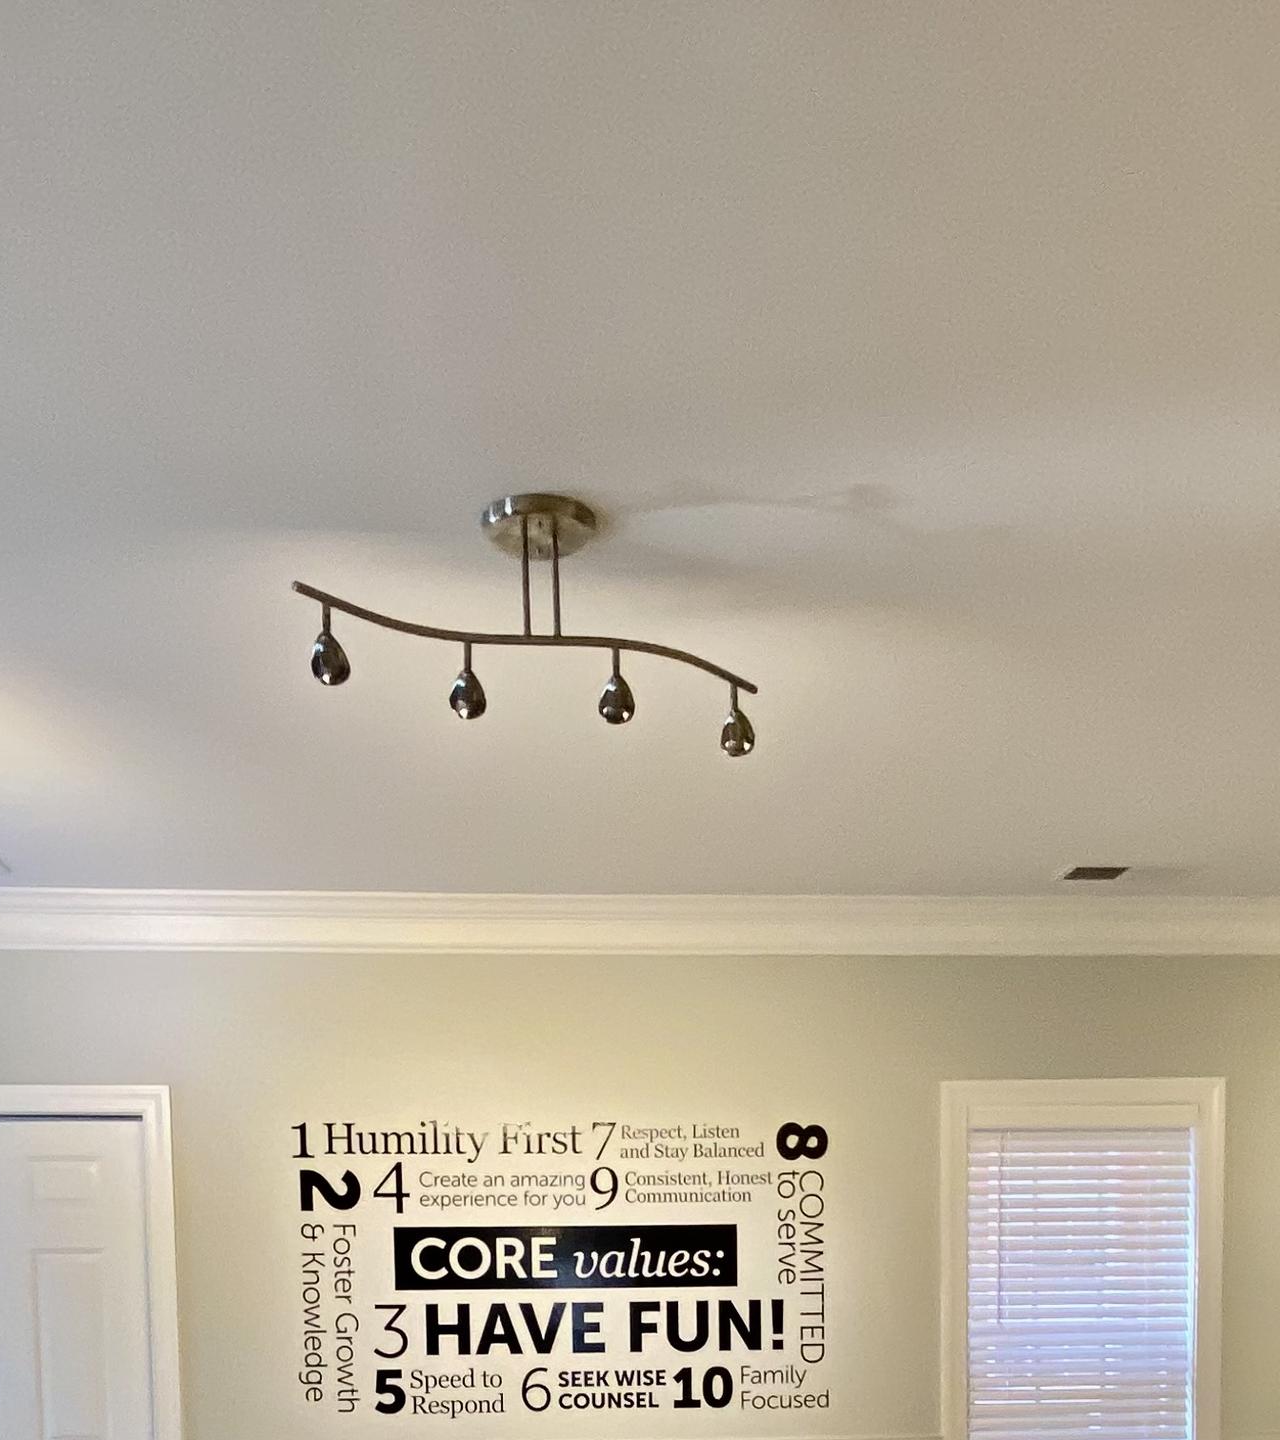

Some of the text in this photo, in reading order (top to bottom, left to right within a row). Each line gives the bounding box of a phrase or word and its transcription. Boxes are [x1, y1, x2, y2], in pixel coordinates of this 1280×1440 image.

[291, 1121, 582, 1164] 1 Humility First
[592, 1122, 739, 1160] 7 Respect, Listen
[620, 1142, 764, 1161] and Stay Balanced
[374, 1162, 585, 1213] 4 Create an amazing
[420, 1191, 585, 1210] experience for you
[590, 1167, 772, 1210] 9 Consistent, Honest
[625, 1186, 751, 1203] Communication
[776, 1122, 828, 1363] 8 COMMITTED
[778, 1170, 799, 1284] to serve
[411, 1237, 724, 1279] CORE values:
[300, 1170, 361, 1412] 2 Foster Growth
[299, 1253, 328, 1401] Knowledge
[374, 1299, 784, 1358] 3 HAVE FUN!
[375, 1368, 502, 1414] 5 Speed to
[411, 1392, 504, 1418] Respond
[522, 1367, 666, 1412] 6 SEEK WISE
[559, 1392, 659, 1409] COUNSEL
[673, 1365, 807, 1408] 10 Family
[741, 1389, 829, 1409] Focused
